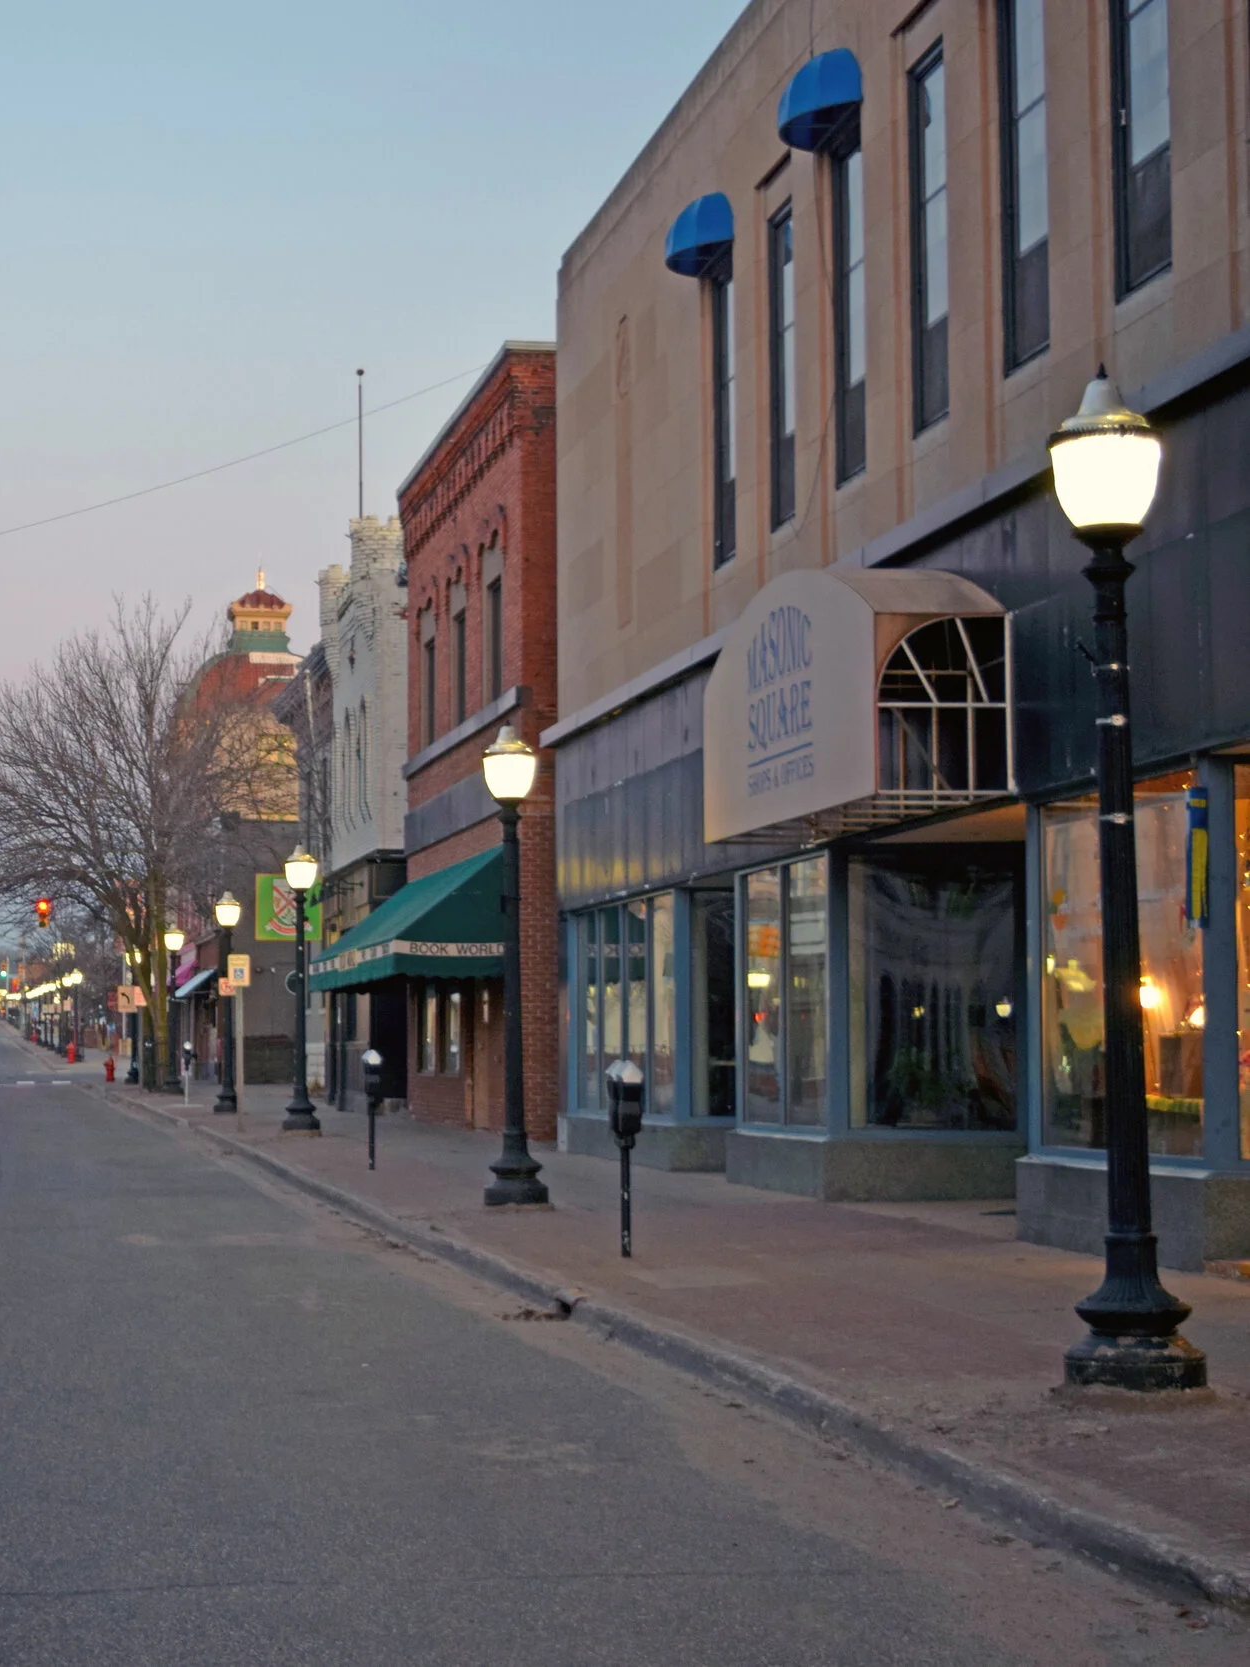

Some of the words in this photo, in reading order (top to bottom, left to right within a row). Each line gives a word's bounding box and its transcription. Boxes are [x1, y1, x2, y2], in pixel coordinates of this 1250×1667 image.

[747, 604, 812, 695] MASONIC
[747, 680, 813, 752] SQUARE
[410, 942, 449, 955] BOOK
[455, 943, 505, 955] WORLD
